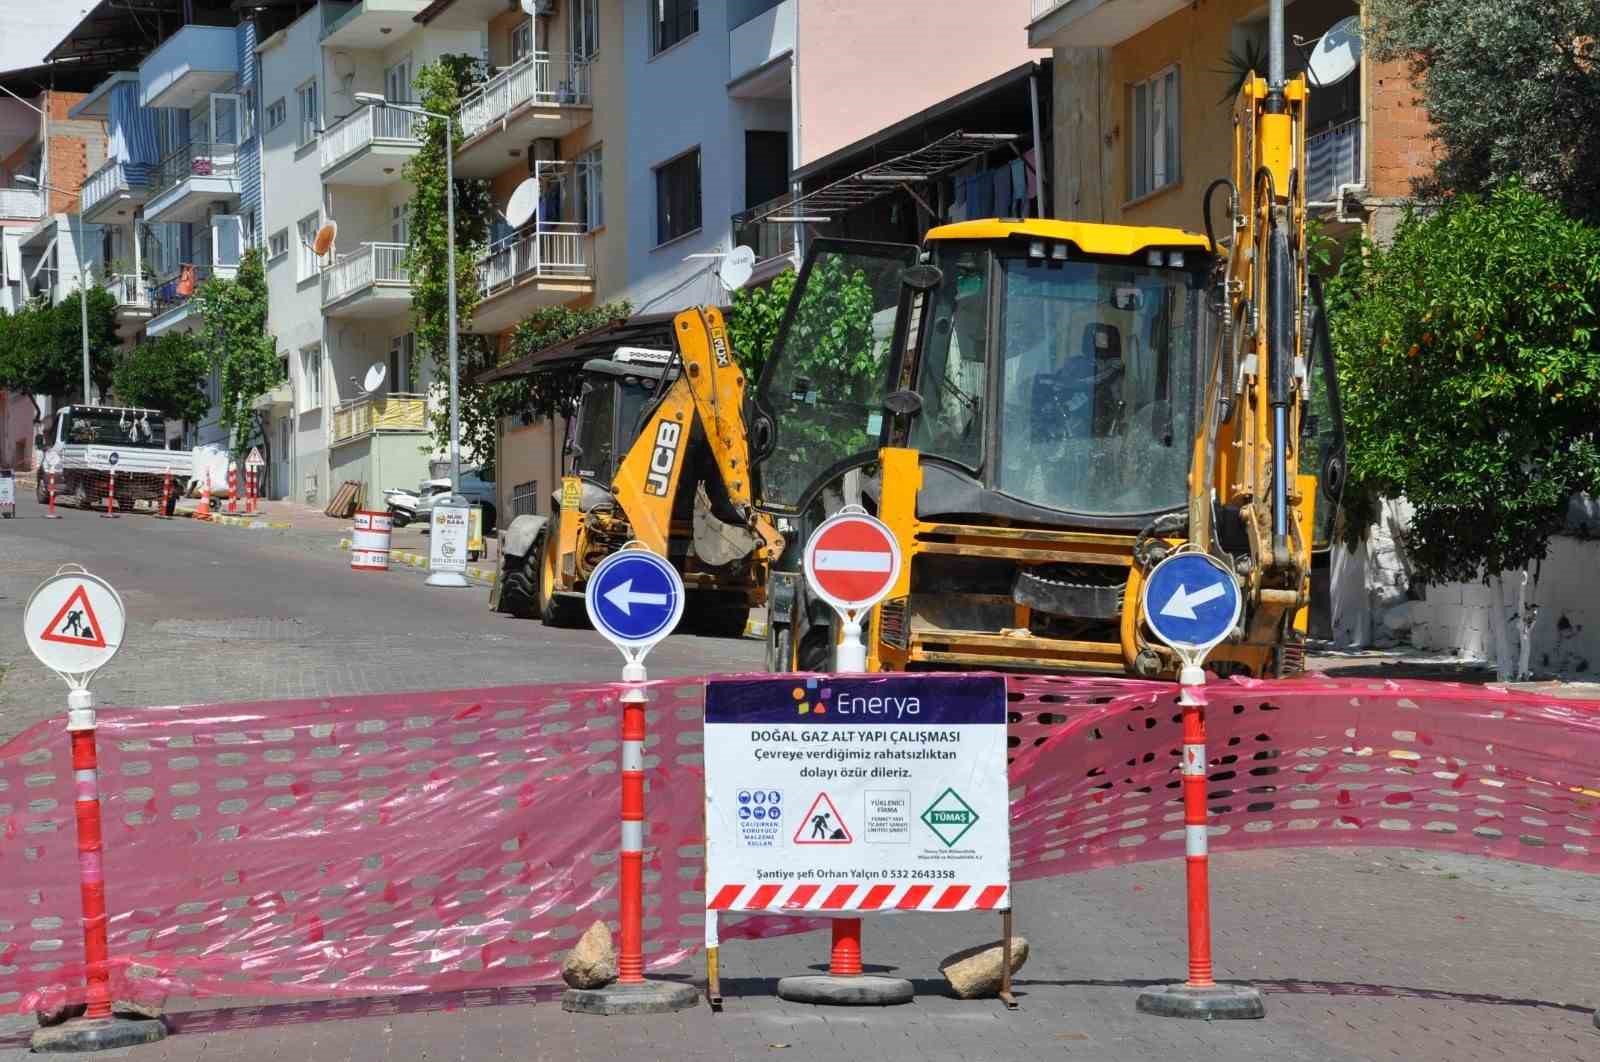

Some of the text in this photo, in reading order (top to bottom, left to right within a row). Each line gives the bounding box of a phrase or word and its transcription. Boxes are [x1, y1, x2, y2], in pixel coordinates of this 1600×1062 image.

[645, 421, 681, 496] JCB
[838, 694, 920, 718] Enerya
[751, 729, 961, 745] DOĞAL GAZ ALT YAPI ÇALIŞMASI
[754, 748, 957, 763] Çevreye verdiğimiz rahatsızlıktan
[800, 766, 912, 780] dolayı özür dileriz.
[934, 811, 967, 823] TÜMAŞ
[756, 868, 956, 881] Şantiye şefi Orhan Yalçın 0 532 2643358
